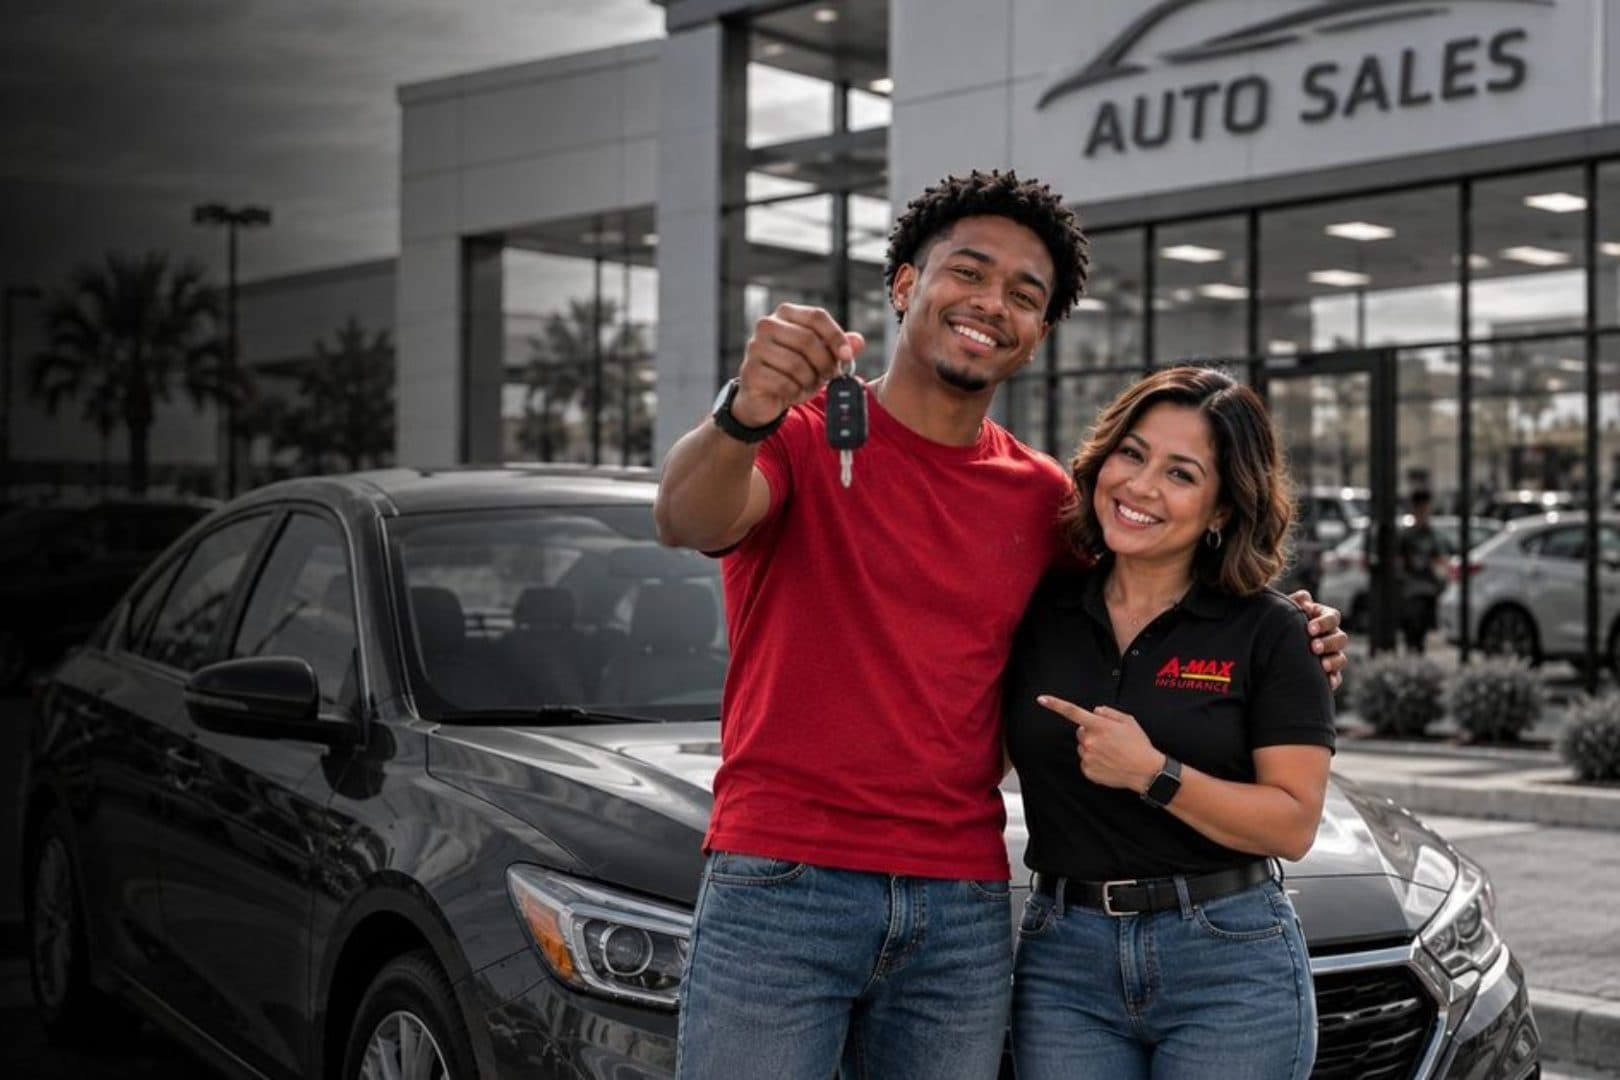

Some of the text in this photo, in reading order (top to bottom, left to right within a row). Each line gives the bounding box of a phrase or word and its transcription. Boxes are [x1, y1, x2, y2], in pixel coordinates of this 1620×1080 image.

[1084, 28, 1528, 158] AUTO SALES
[1157, 657, 1235, 678] A-MAX
[1154, 678, 1231, 694] INSURANCE
